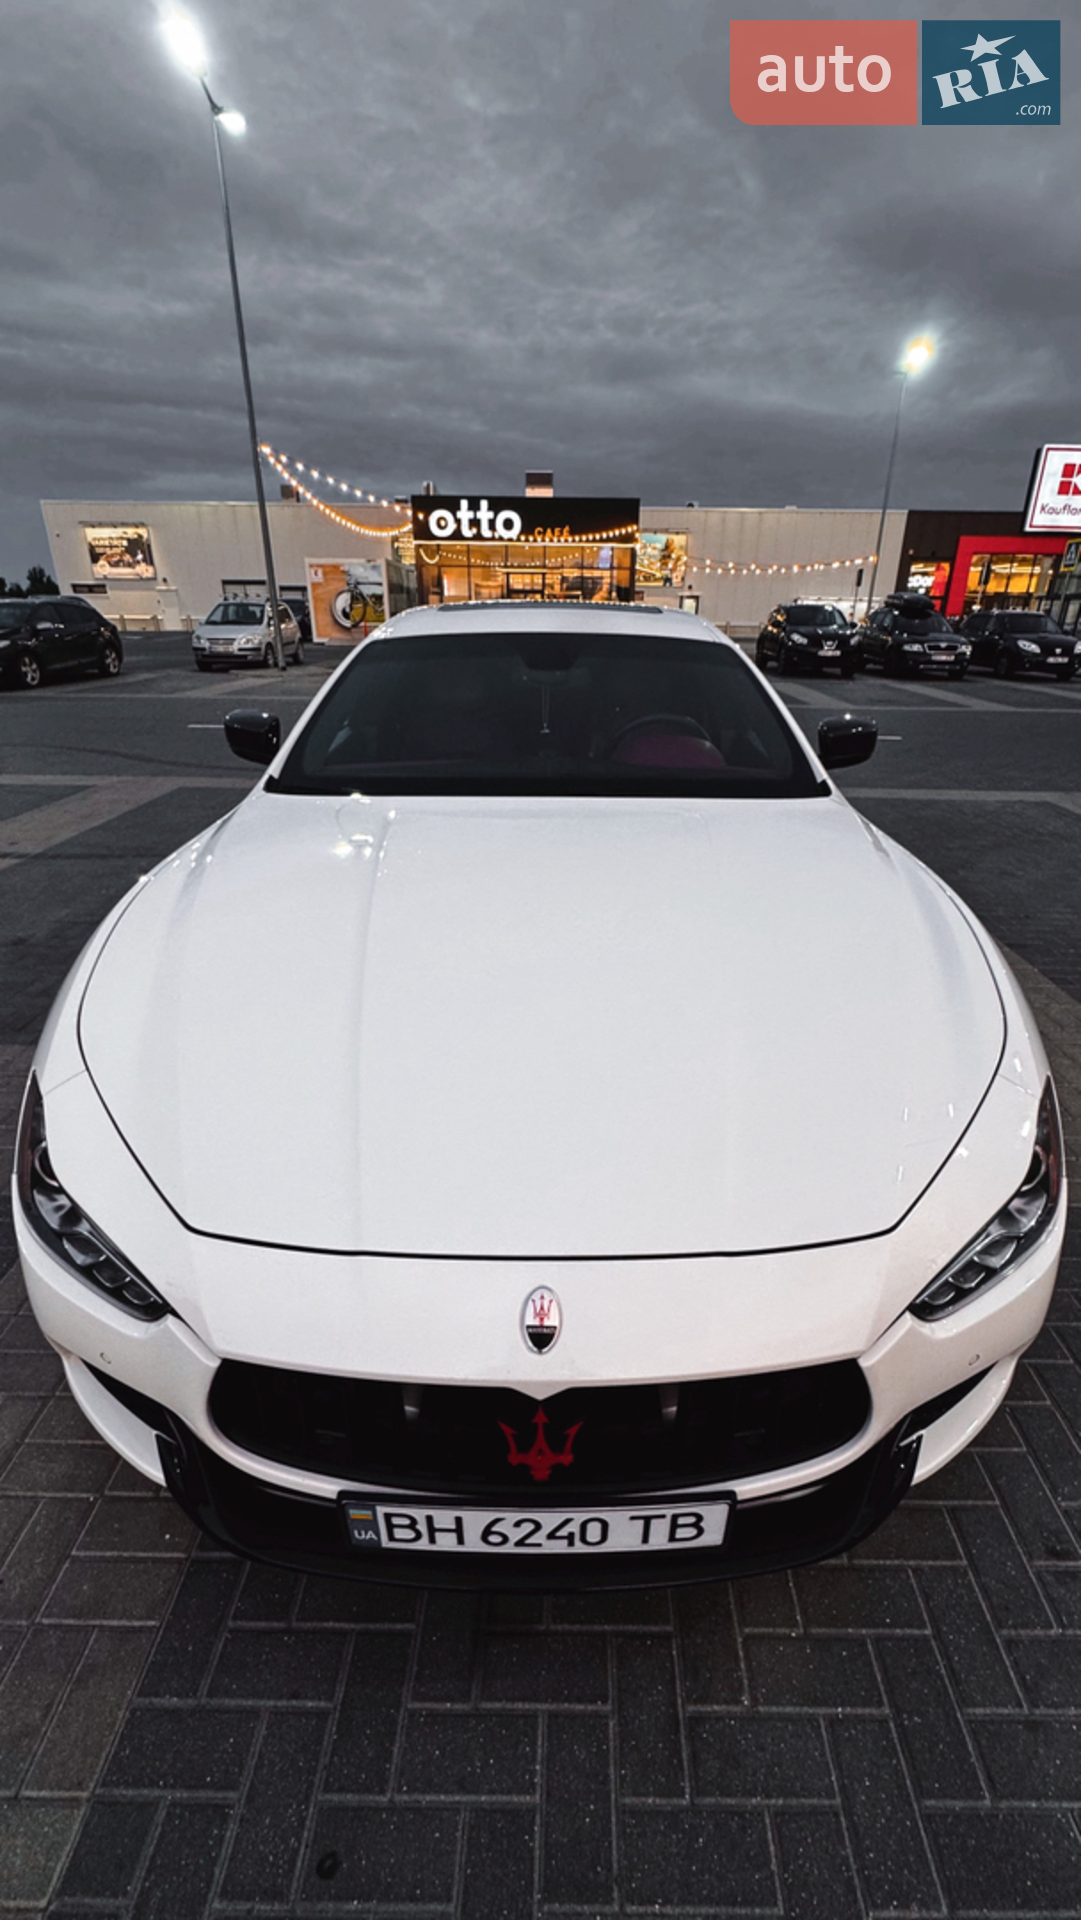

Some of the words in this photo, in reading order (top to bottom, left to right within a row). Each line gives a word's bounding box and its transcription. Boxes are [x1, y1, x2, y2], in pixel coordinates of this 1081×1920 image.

[428, 499, 522, 539] otto
[534, 525, 571, 540] CAFÉ
[354, 1529, 378, 1541] UA
[383, 1512, 465, 1545] BH
[480, 1517, 609, 1547] 6240
[629, 1512, 705, 1544] TB
